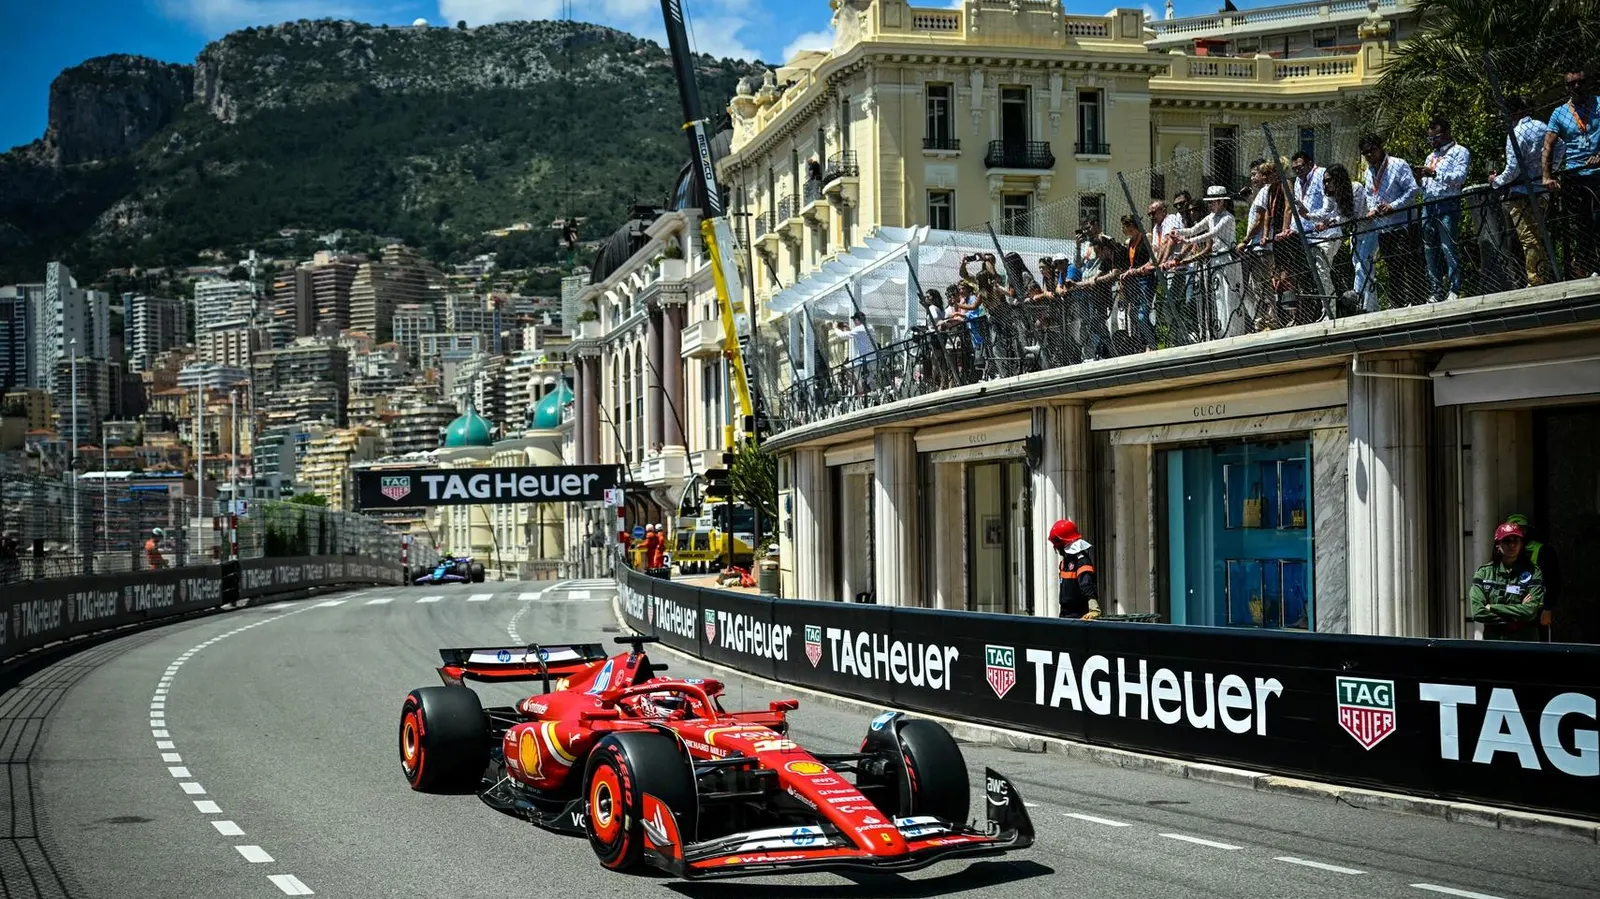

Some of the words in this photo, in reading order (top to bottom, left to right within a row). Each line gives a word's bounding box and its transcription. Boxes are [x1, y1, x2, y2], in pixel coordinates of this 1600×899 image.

[1194, 404, 1226, 417] GUCCI
[807, 629, 820, 641] TAG
[988, 649, 1013, 667] TAG
[987, 667, 1015, 692] HEUER
[1341, 682, 1389, 706] TAG
[1341, 708, 1392, 744] HEUER
[1419, 682, 1600, 777] TAG
[685, 739, 709, 752] RICHARD
[710, 745, 727, 757] MILLE
[987, 777, 1008, 795] aws
[855, 823, 896, 833] Santander
[742, 855, 805, 863] V-Power
